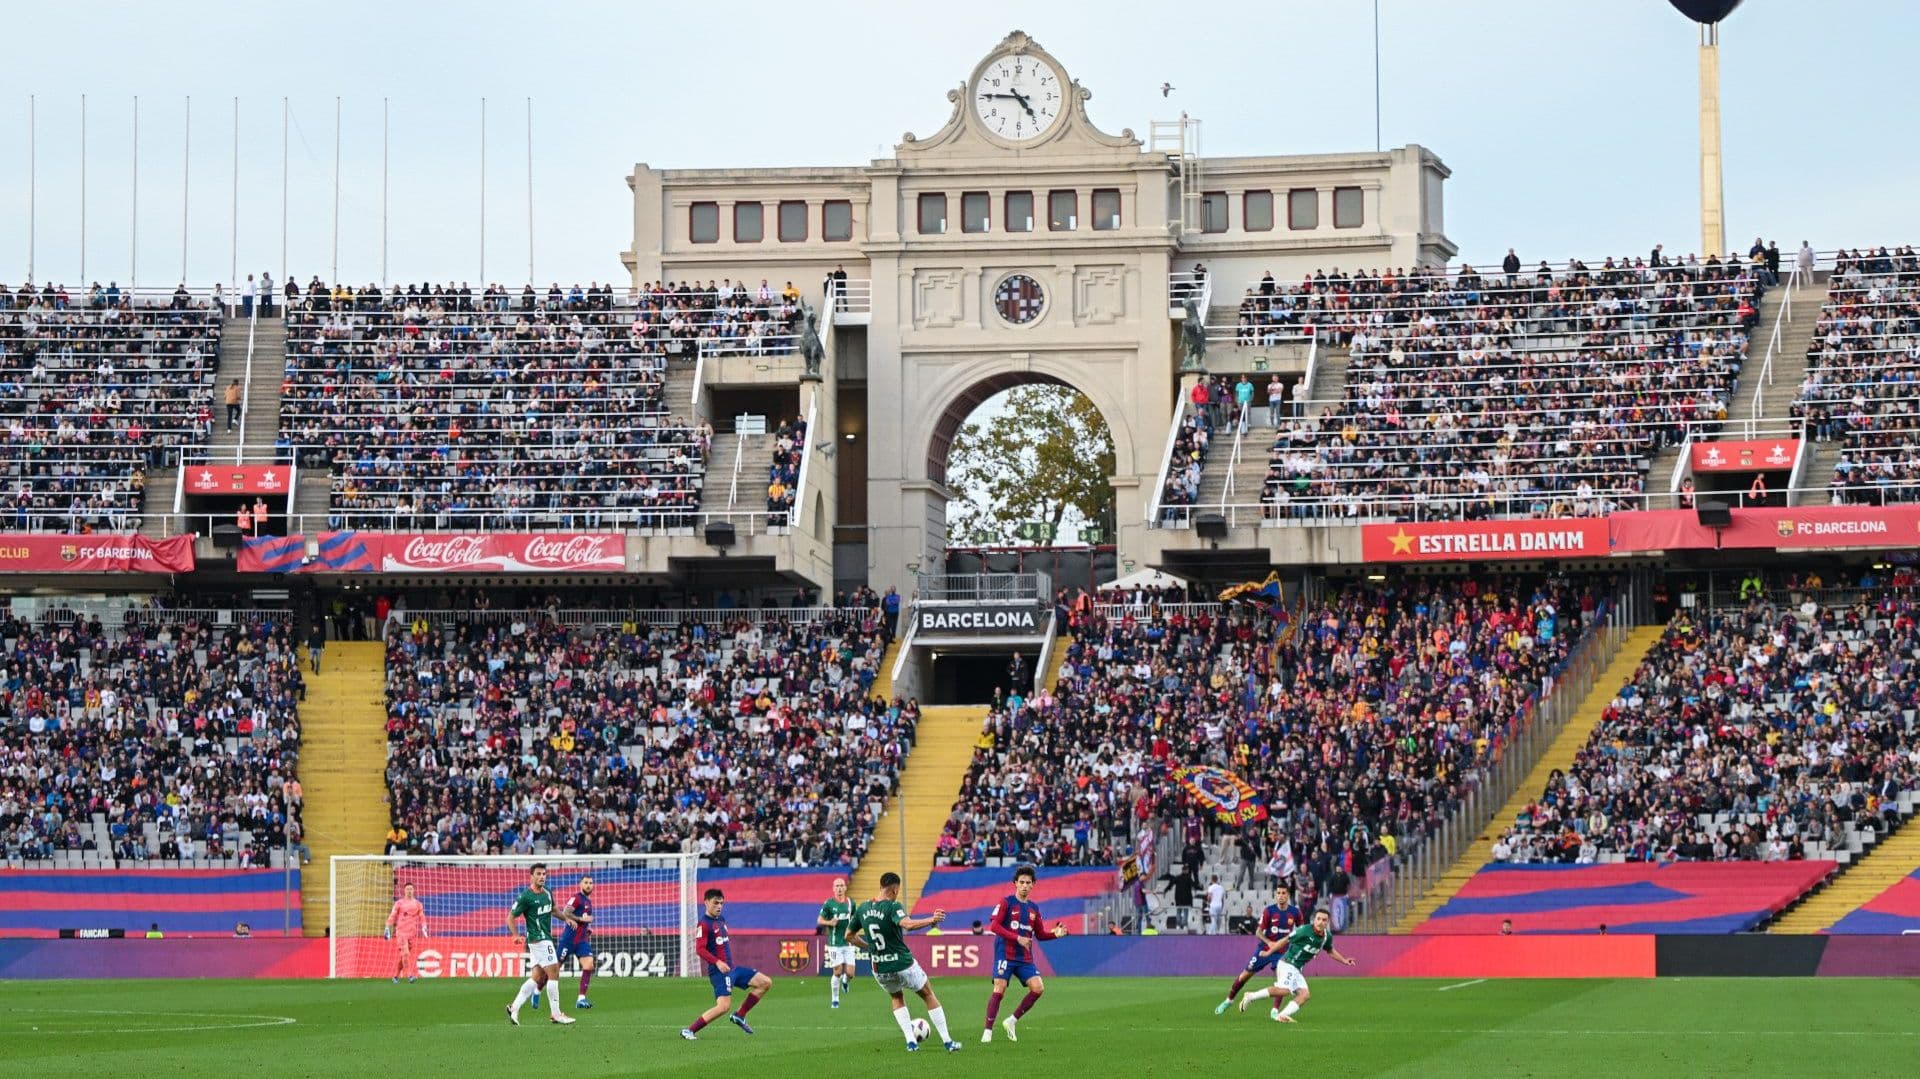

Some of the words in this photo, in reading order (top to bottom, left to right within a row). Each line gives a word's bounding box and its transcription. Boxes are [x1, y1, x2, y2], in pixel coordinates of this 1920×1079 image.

[1015, 65, 1023, 74] 12
[992, 79, 1000, 87] 10
[1041, 77, 1047, 85] 2
[1046, 93, 1051, 101] 3
[991, 108, 997, 116] 8
[1041, 107, 1046, 115] 4
[1001, 117, 1006, 125] 7
[1032, 116, 1037, 124] 5
[1016, 122, 1021, 130] 6
[1797, 522, 1813, 534] FC
[1815, 521, 1887, 534] BARCELONA
[1419, 533, 1516, 553] ESTRELLA
[1520, 531, 1584, 551] DAMM
[0, 547, 29, 557] CLUB
[80, 547, 95, 559] FC
[404, 535, 486, 563] Coca-Cola
[524, 535, 607, 563] Coca-Cola
[922, 612, 1035, 628] BARCELONA
[869, 923, 886, 951] 5
[547, 945, 554, 954] 6
[561, 947, 568, 957] 5
[871, 953, 899, 963] DIGI
[931, 945, 979, 968] FES
[1249, 956, 1257, 966] 2
[597, 952, 666, 977] 2024
[997, 960, 1008, 970] 14
[1287, 972, 1293, 980] 2
